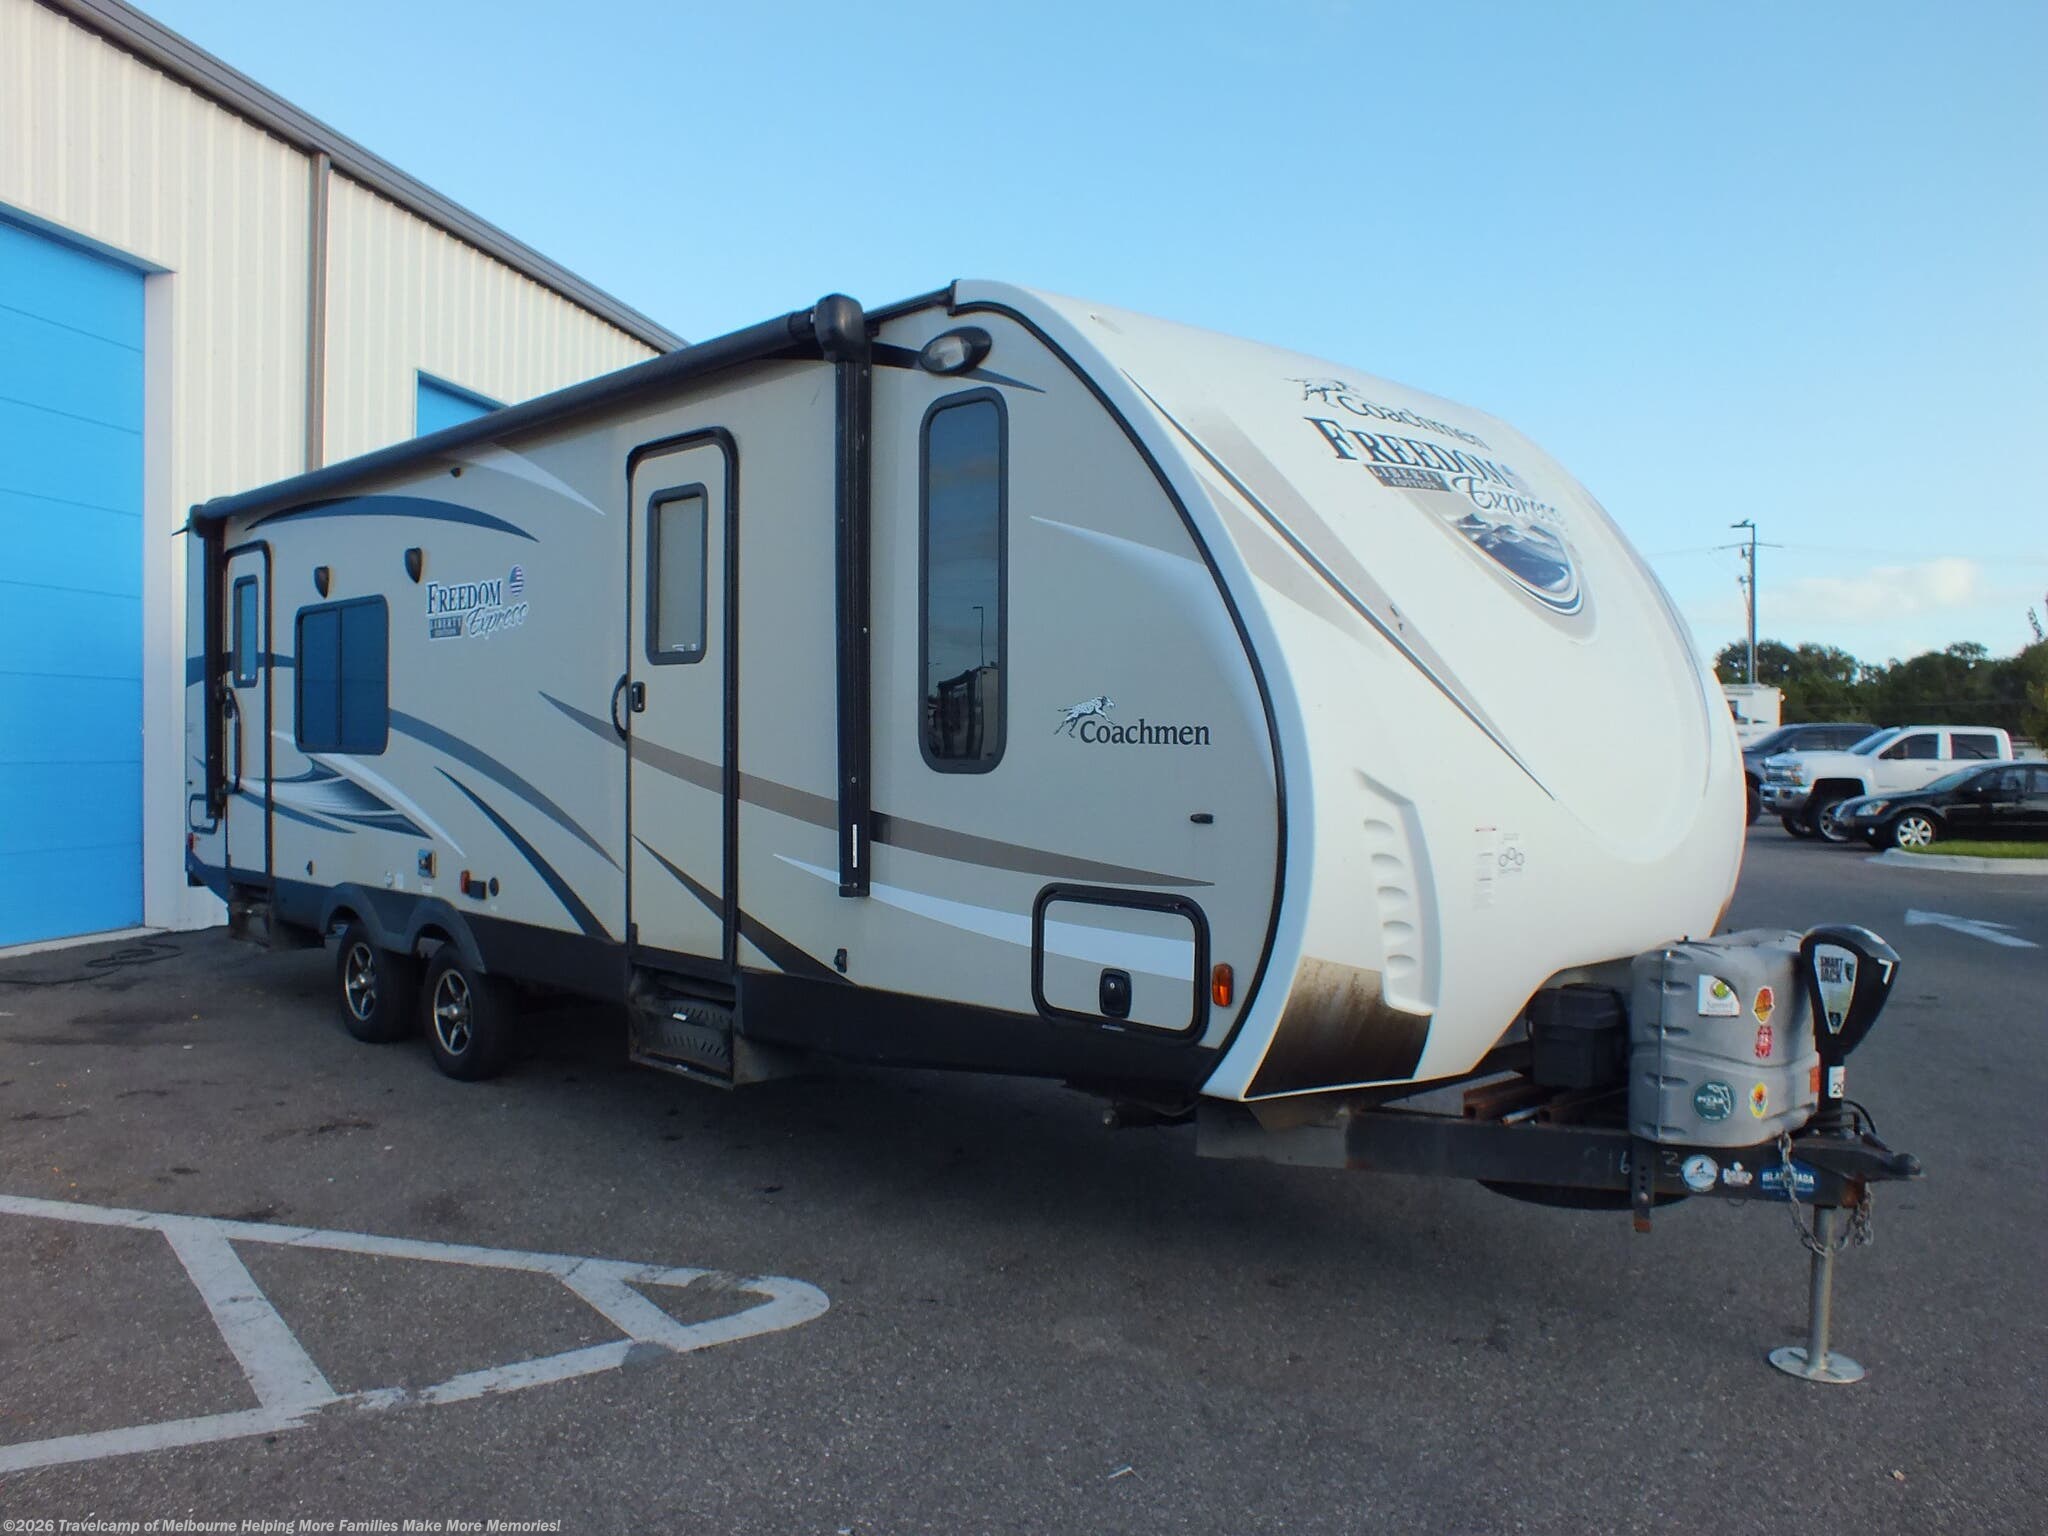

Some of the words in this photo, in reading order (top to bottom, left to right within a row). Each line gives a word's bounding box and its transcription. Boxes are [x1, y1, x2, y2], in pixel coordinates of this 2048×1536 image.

[1337, 395, 1492, 450] Coachmen
[1303, 415, 1516, 490] FREEDOM
[426, 580, 502, 615] FREEDOM
[466, 603, 528, 638] Express
[1079, 718, 1211, 746] Coachmen
